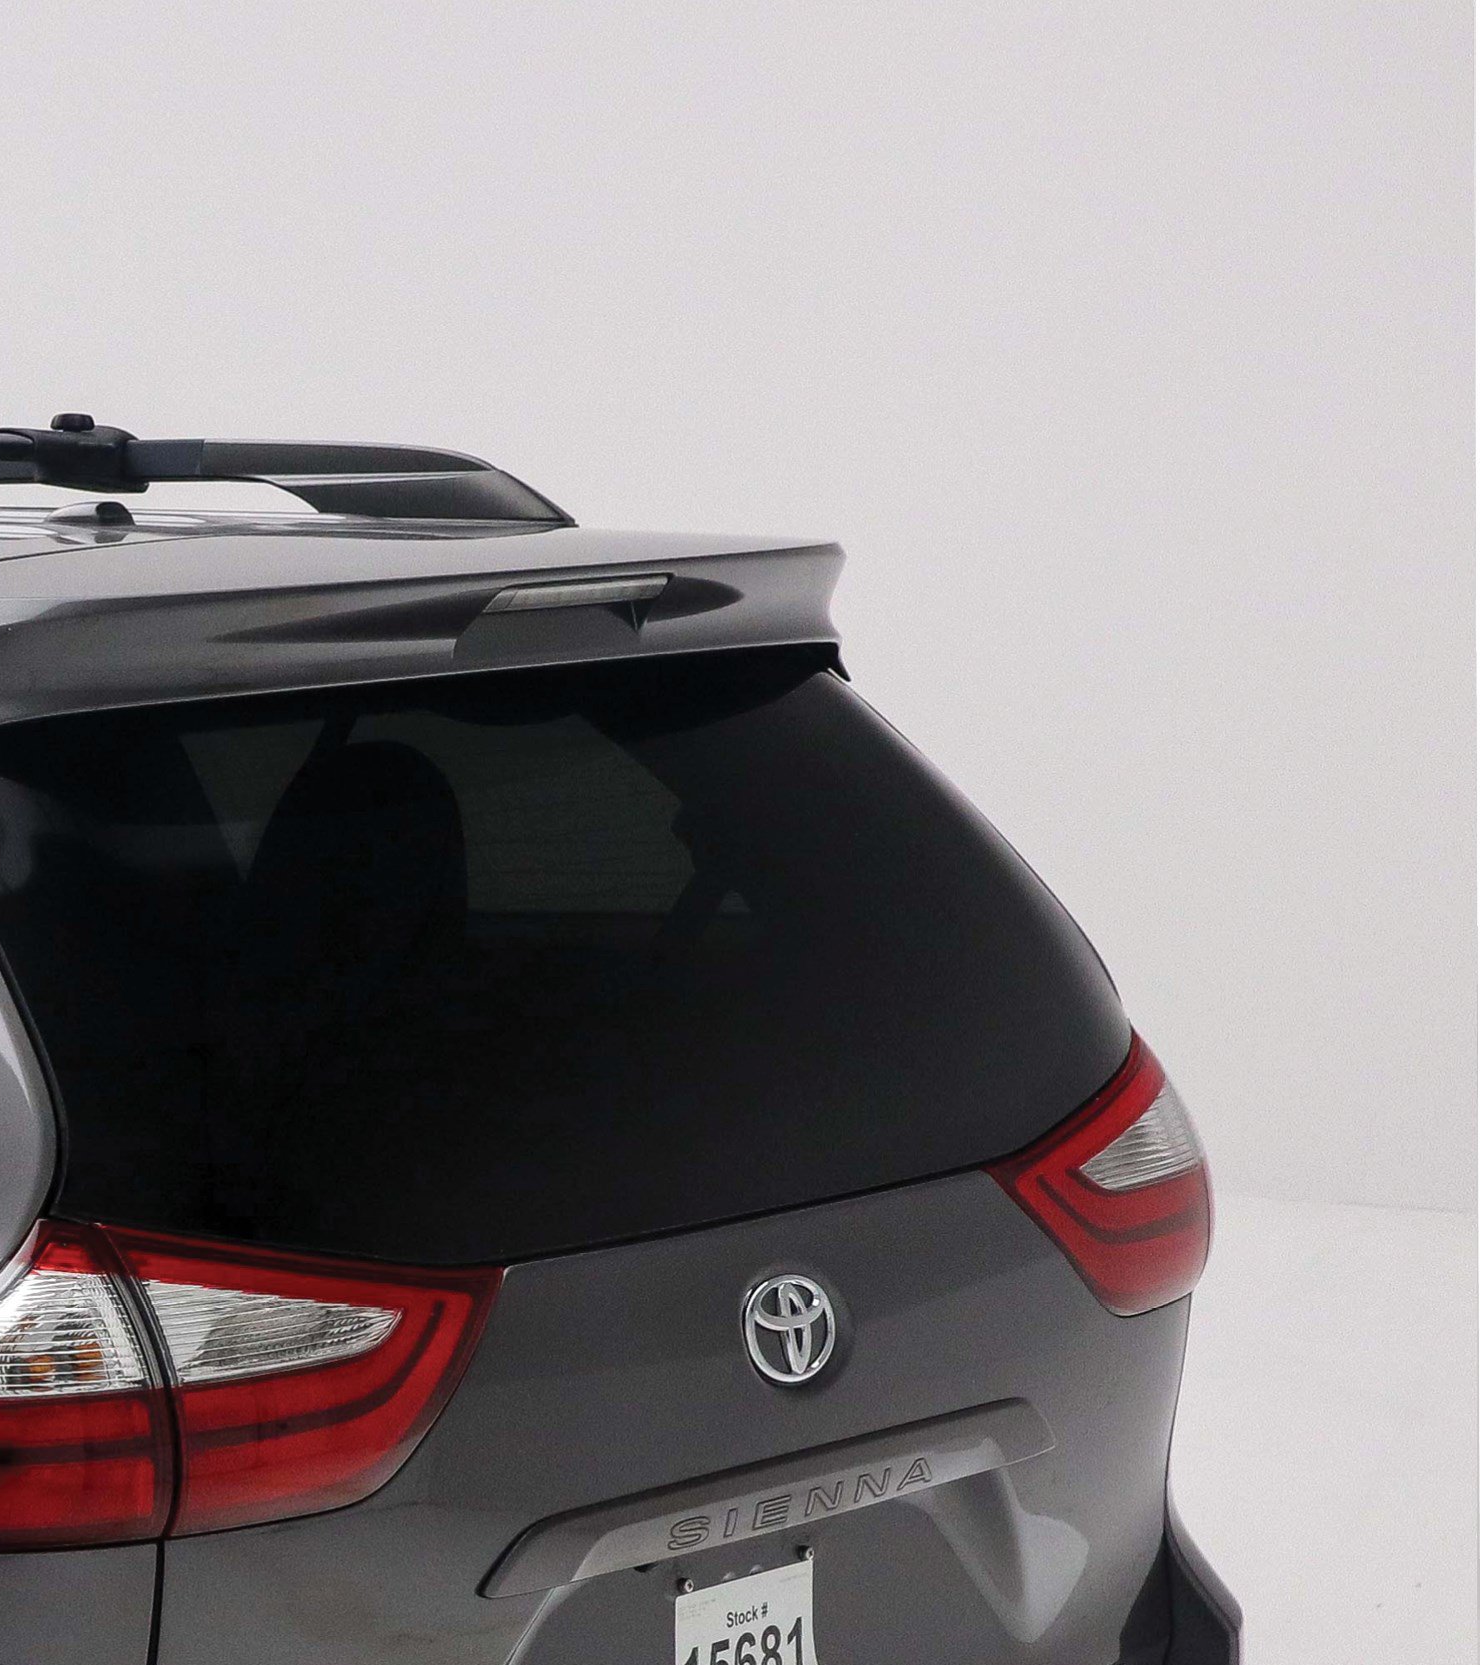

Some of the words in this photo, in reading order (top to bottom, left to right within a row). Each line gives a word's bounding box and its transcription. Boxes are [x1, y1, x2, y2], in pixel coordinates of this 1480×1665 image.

[667, 1457, 933, 1551] SIENNA
[726, 1605, 759, 1629] Stock
[760, 1602, 769, 1618] #
